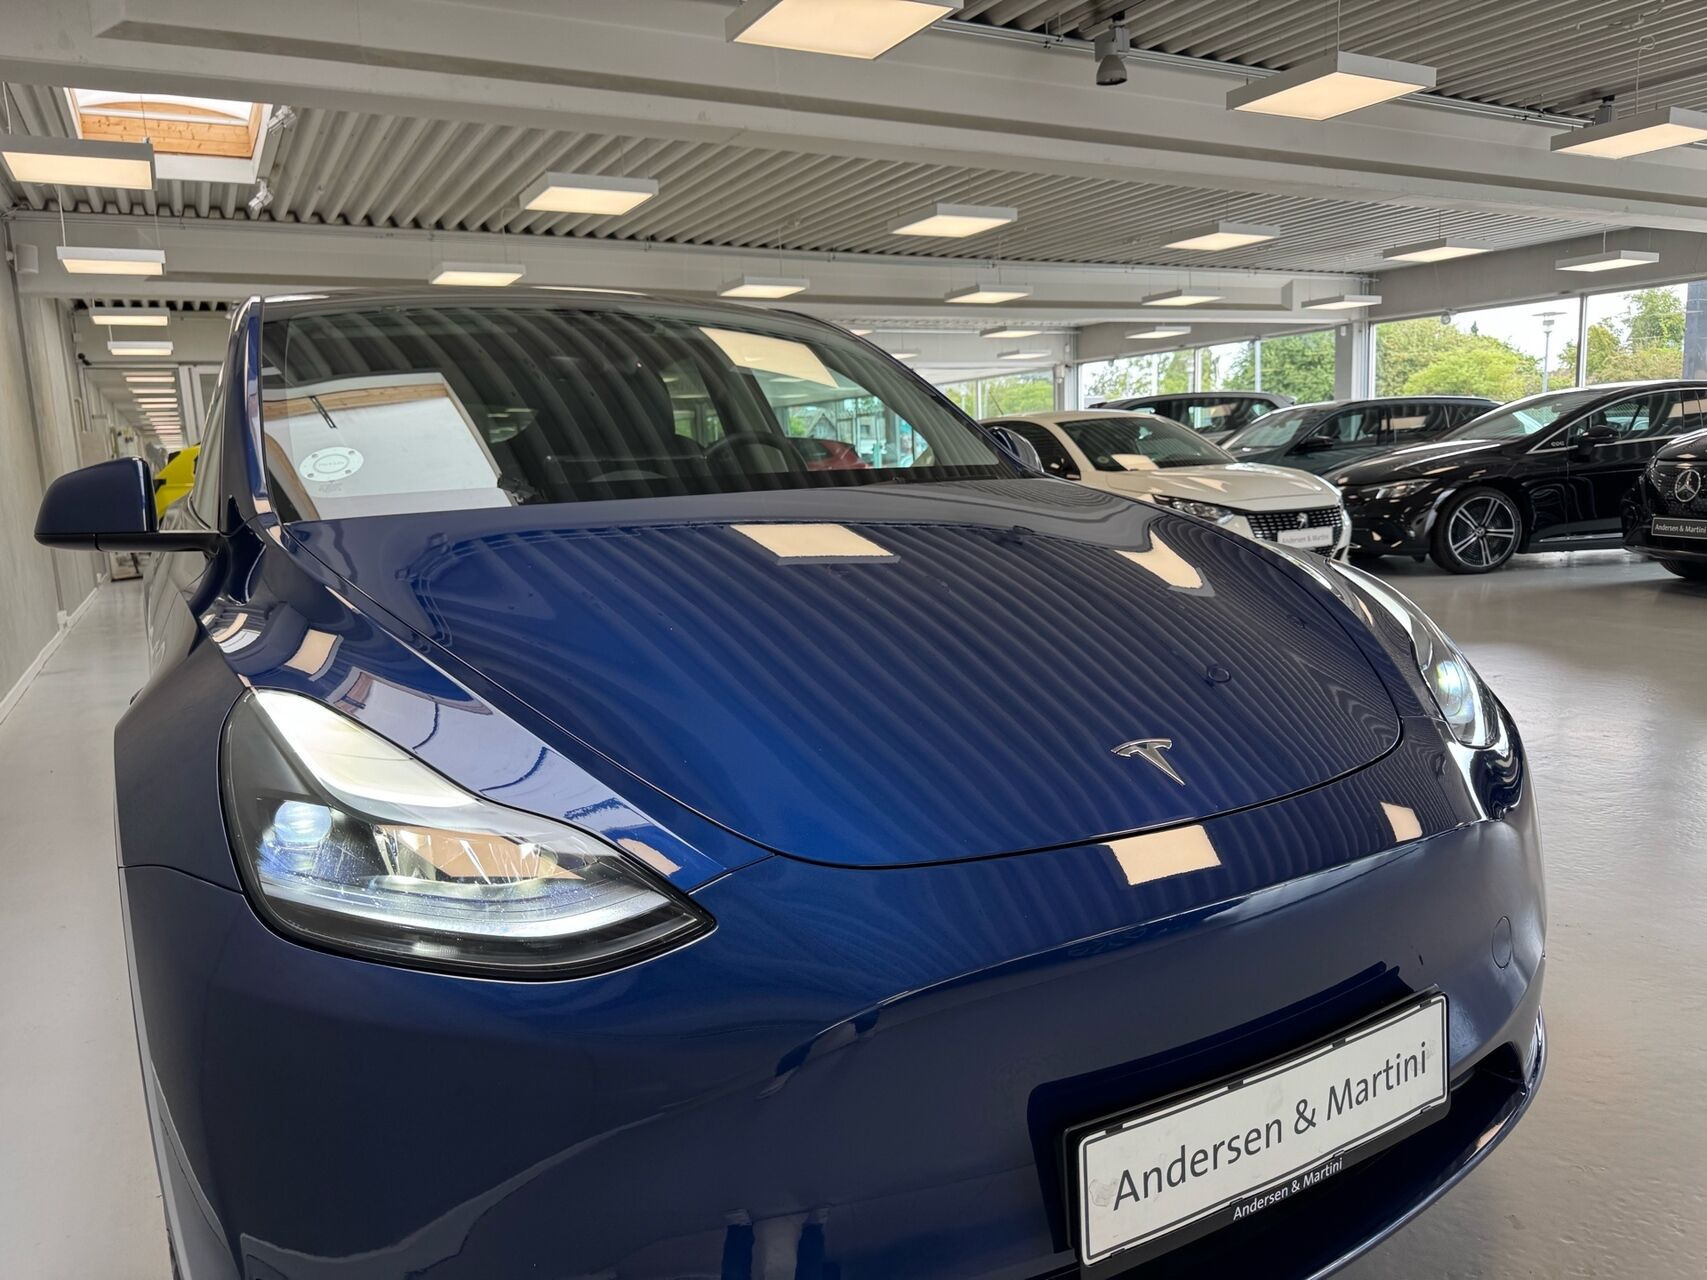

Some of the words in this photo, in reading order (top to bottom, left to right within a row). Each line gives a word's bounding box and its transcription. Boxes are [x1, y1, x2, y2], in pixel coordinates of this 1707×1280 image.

[1655, 523, 1678, 532] Andersen
[1685, 525, 1707, 533] Martini
[1113, 1118, 1282, 1211] Andersen
[1294, 1098, 1317, 1135] &
[1326, 1041, 1426, 1121] Martini
[1233, 1187, 1288, 1221] Andersen
[1291, 1179, 1301, 1193] &
[1303, 1157, 1343, 1188] Martini
